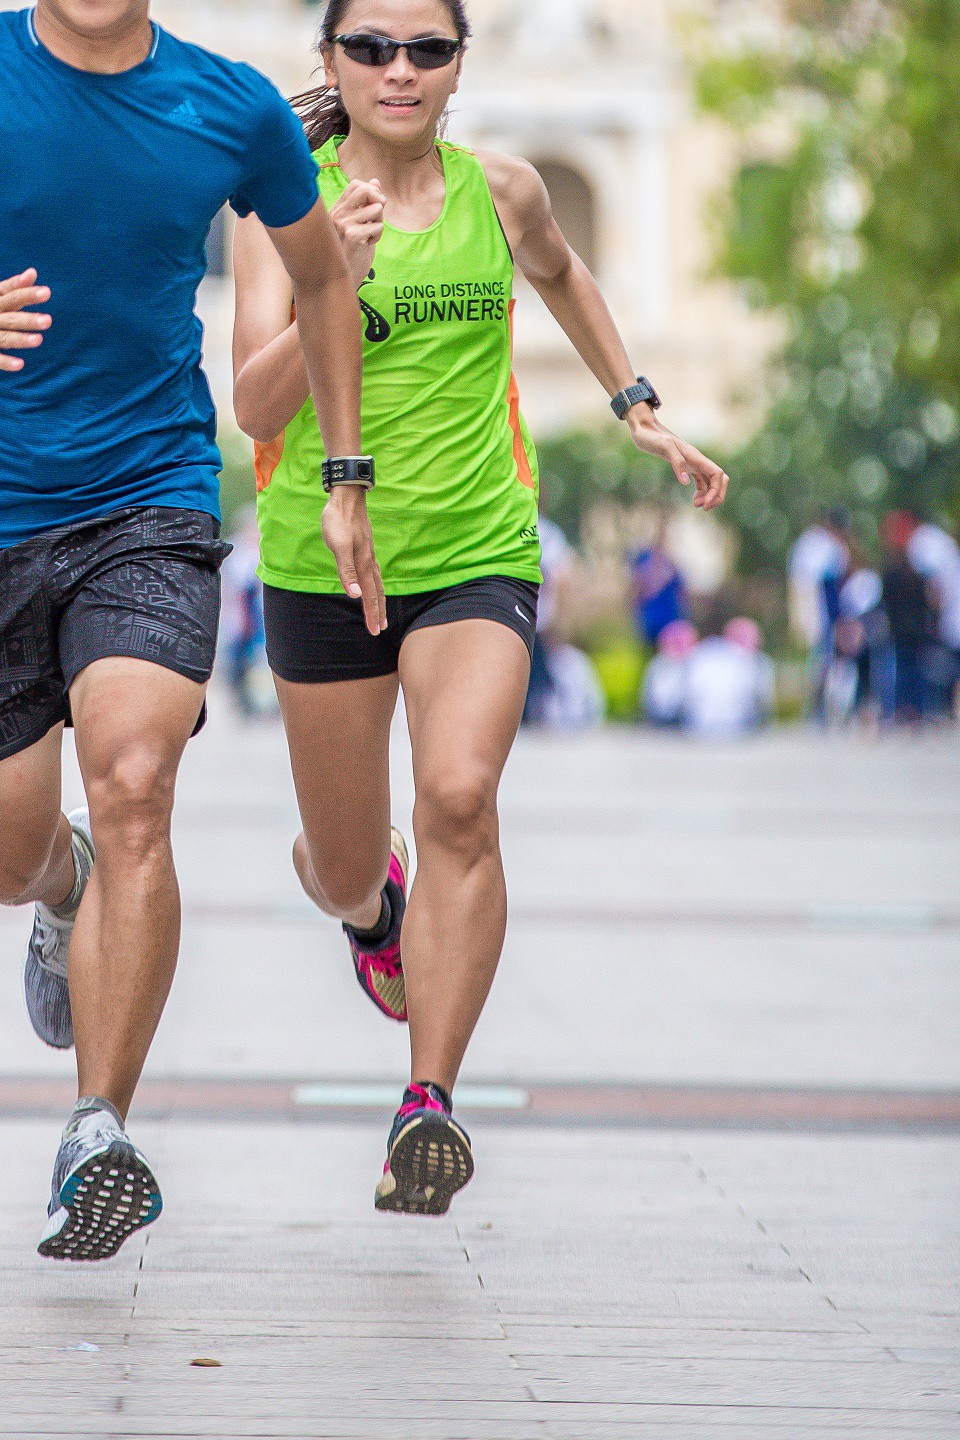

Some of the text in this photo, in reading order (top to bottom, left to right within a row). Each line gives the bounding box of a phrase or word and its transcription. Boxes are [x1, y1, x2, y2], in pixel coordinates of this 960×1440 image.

[394, 281, 505, 299] LONG DISTANCE
[394, 298, 505, 324] RUNNERS
